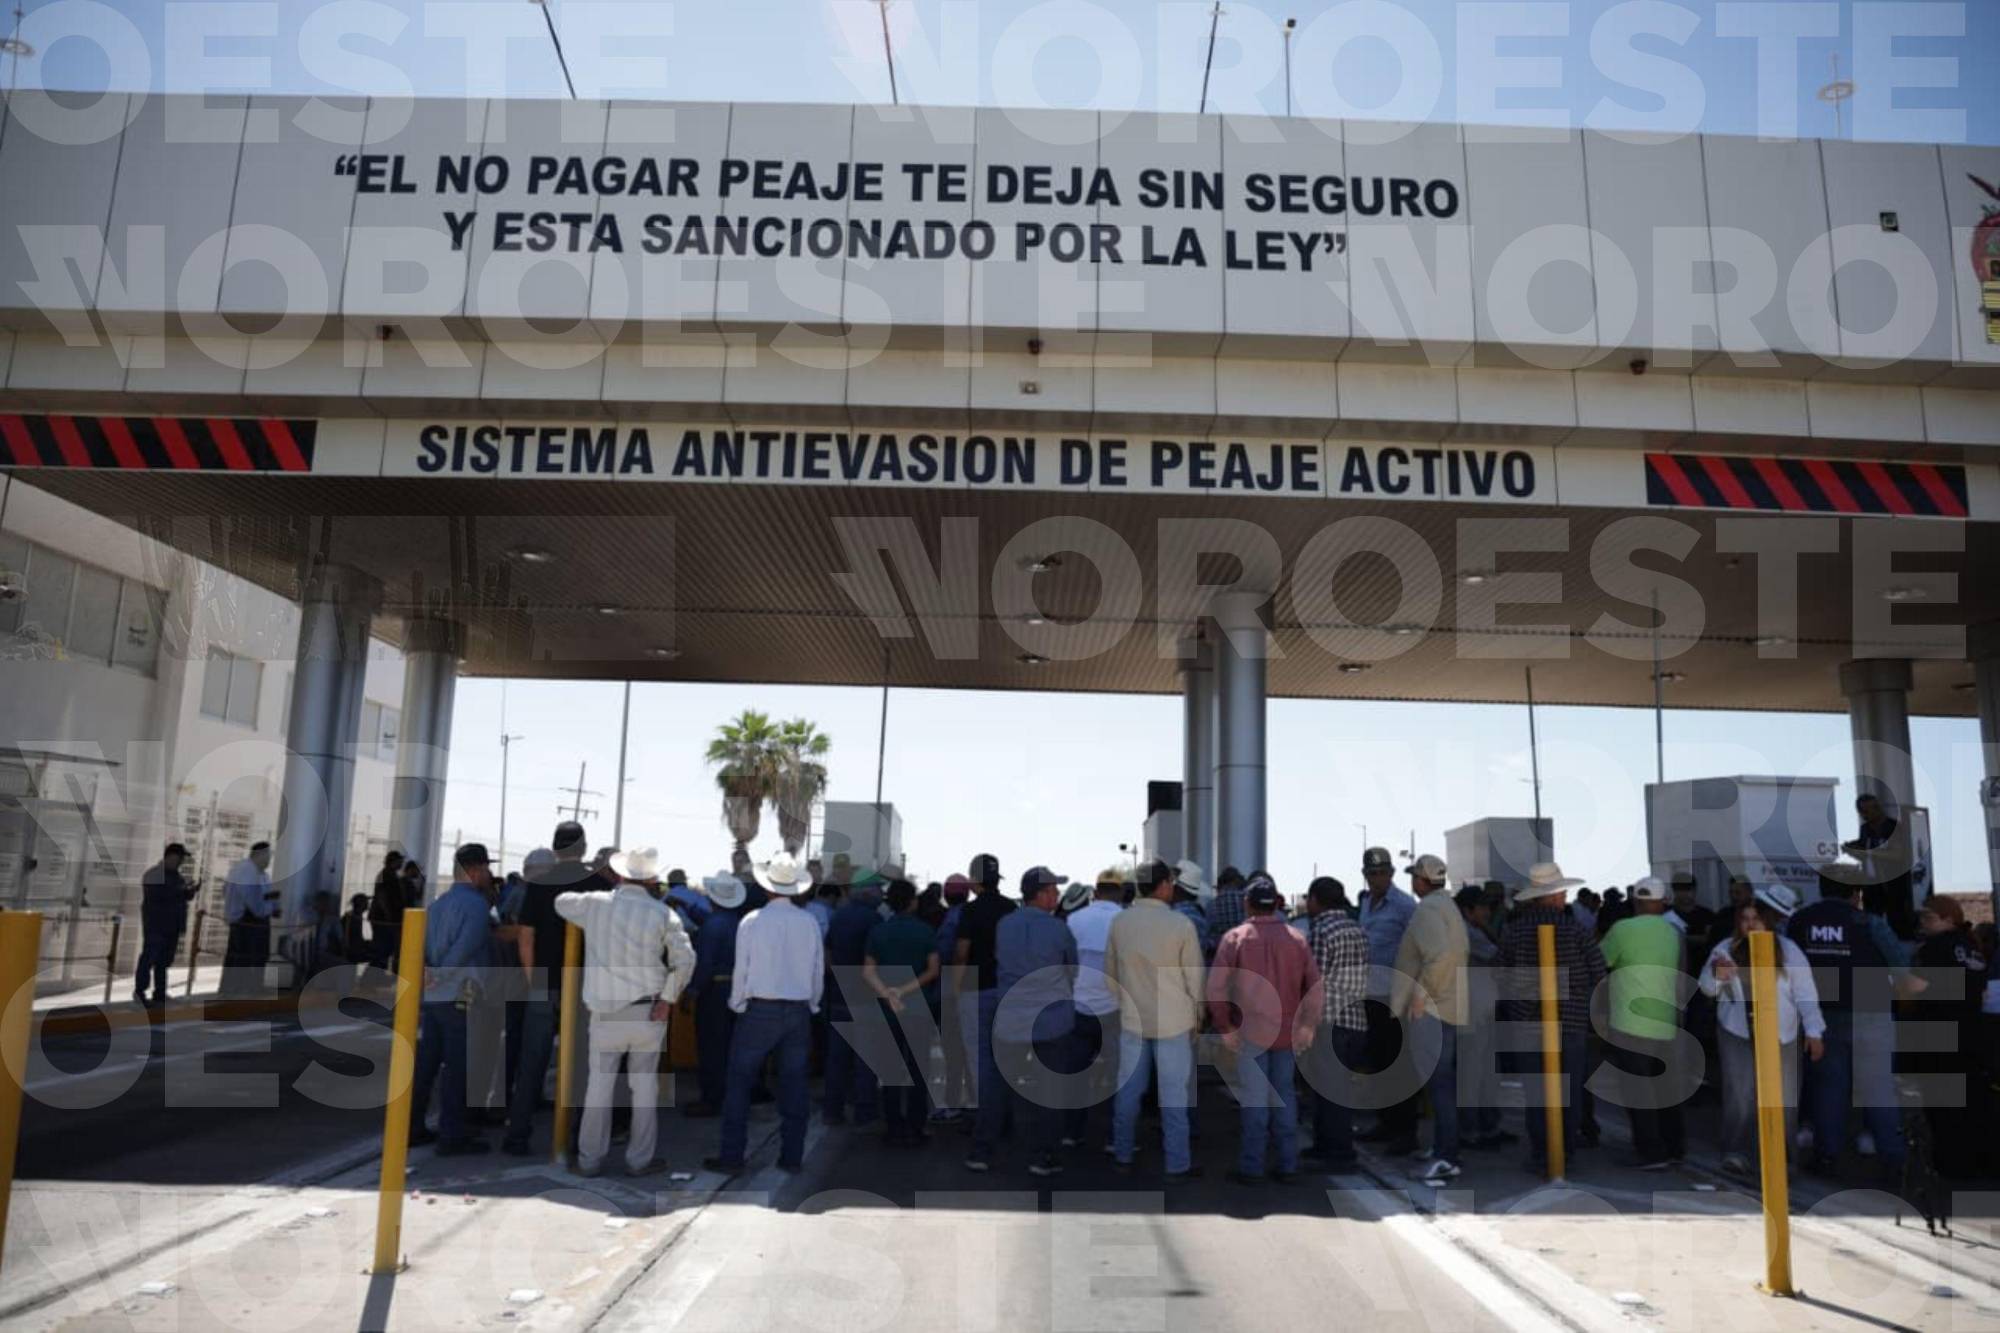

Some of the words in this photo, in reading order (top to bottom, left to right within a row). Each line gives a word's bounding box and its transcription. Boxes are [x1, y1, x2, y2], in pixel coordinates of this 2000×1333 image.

[436, 155, 510, 195] NO
[527, 156, 700, 197] PAGAR
[718, 158, 884, 201] PEAJE
[902, 163, 968, 203] TE
[986, 164, 1121, 207] DEJA
[1138, 168, 1225, 211] SIN
[1245, 173, 1460, 219] SEGURO
[443, 211, 477, 251] Y
[493, 211, 624, 254] ESTA
[641, 214, 996, 260] SANCIONADO
[1015, 222, 1124, 264] POR
[1142, 225, 1207, 268] LA
[416, 425, 655, 476] SISTEMA
[672, 430, 1037, 485] ANTIEVASION
[1060, 438, 1128, 488] DE
[1150, 441, 1321, 492] PEAJE
[1340, 446, 1536, 499] ACTIVO
[1811, 925, 1844, 942] MN
